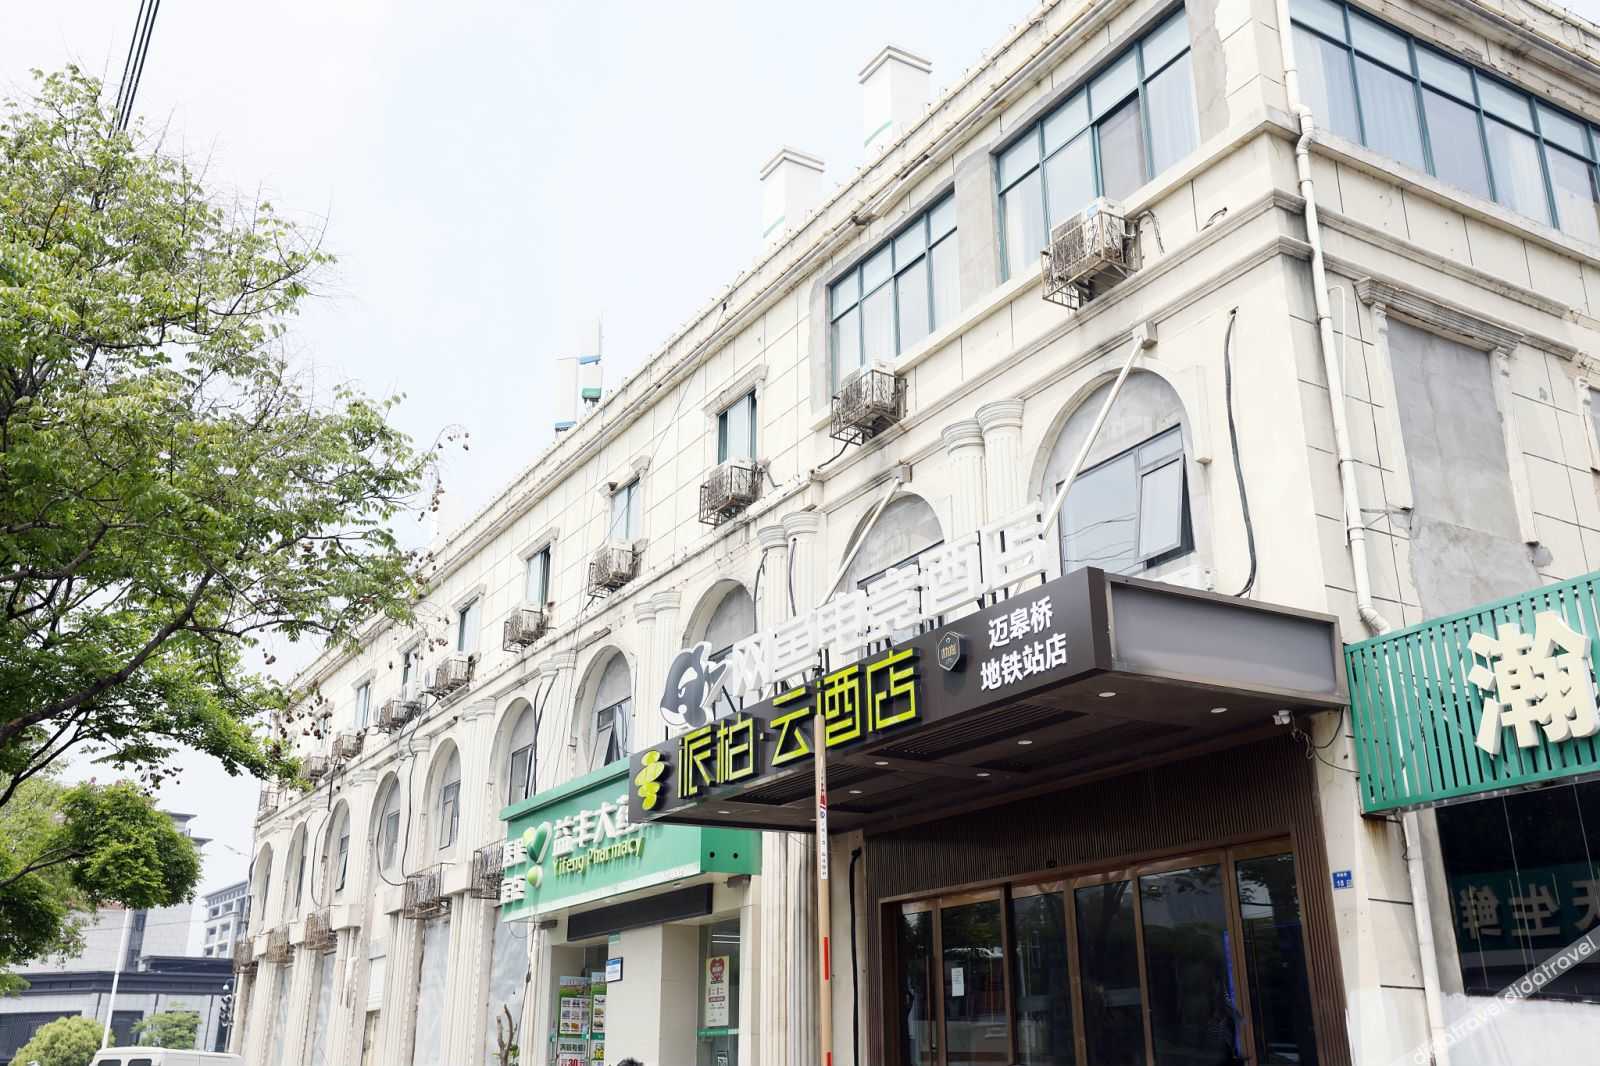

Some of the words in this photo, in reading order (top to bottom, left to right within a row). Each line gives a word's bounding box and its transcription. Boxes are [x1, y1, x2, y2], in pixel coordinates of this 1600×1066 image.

[988, 595, 1053, 650] 迈皋桥
[980, 633, 1067, 692] 地铁站店
[1467, 610, 1597, 757] 瀚
[553, 855, 586, 878] Yifeng
[586, 837, 646, 866] Pharmacy
